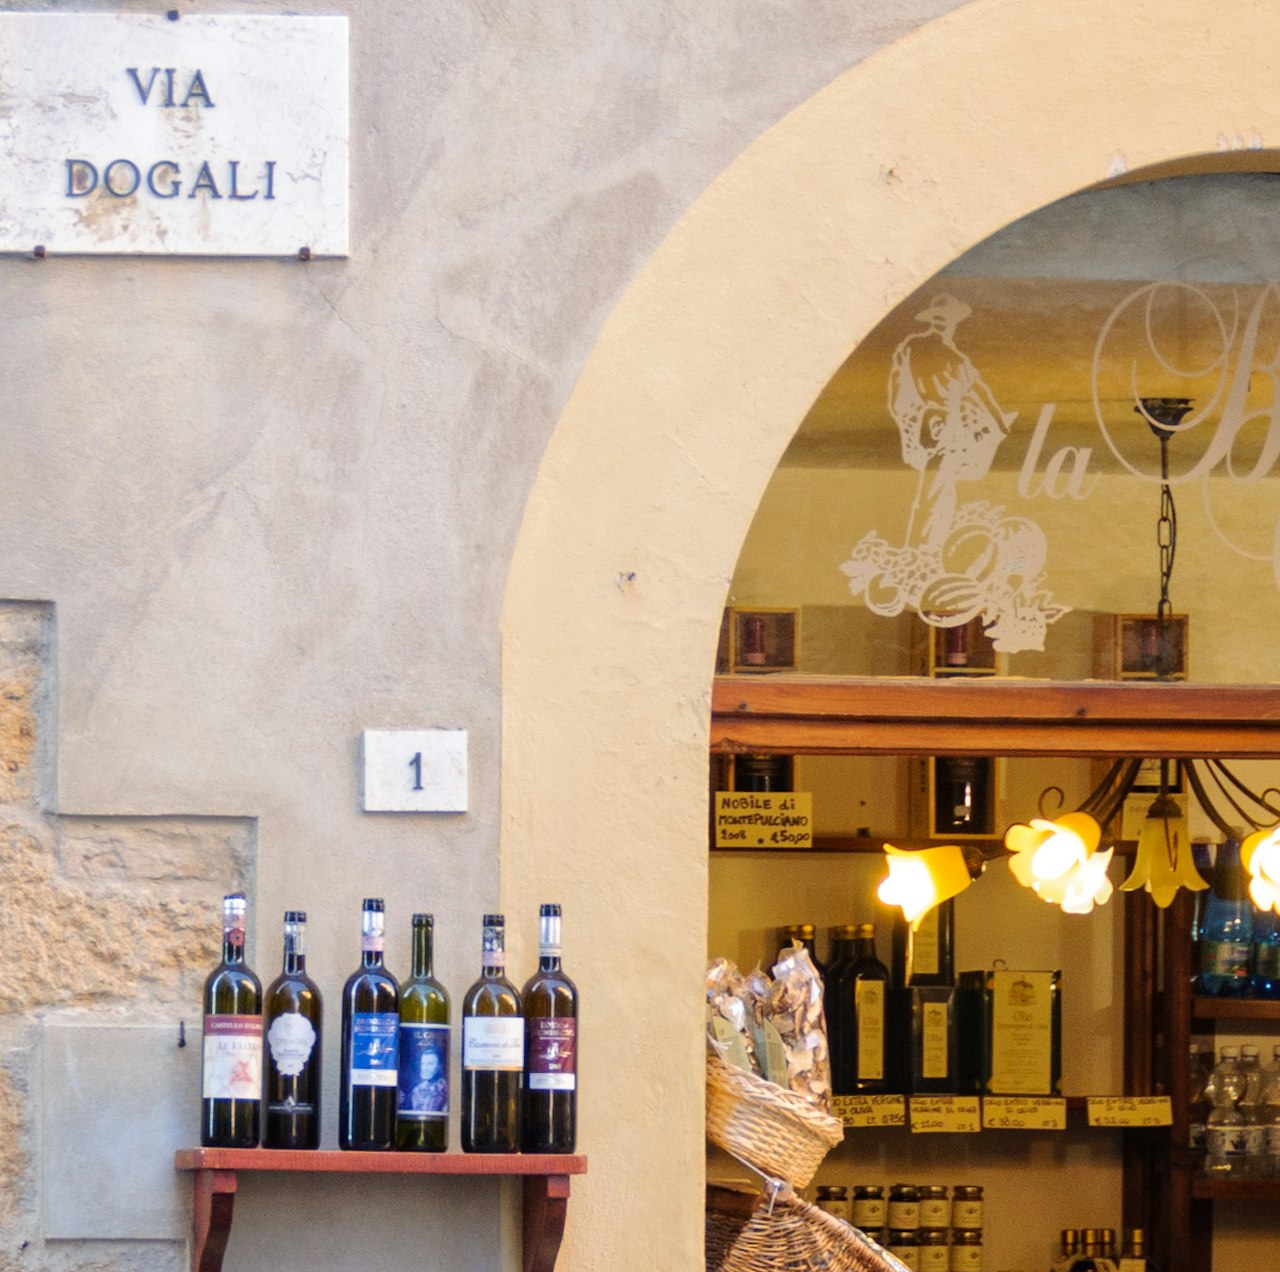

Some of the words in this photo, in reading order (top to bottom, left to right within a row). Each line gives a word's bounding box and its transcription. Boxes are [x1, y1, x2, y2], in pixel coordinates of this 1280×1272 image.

[126, 67, 215, 108] VIA
[64, 158, 277, 200] DOGALI
[1019, 402, 1102, 500] la
[408, 751, 424, 790] 1
[779, 798, 795, 810] di
